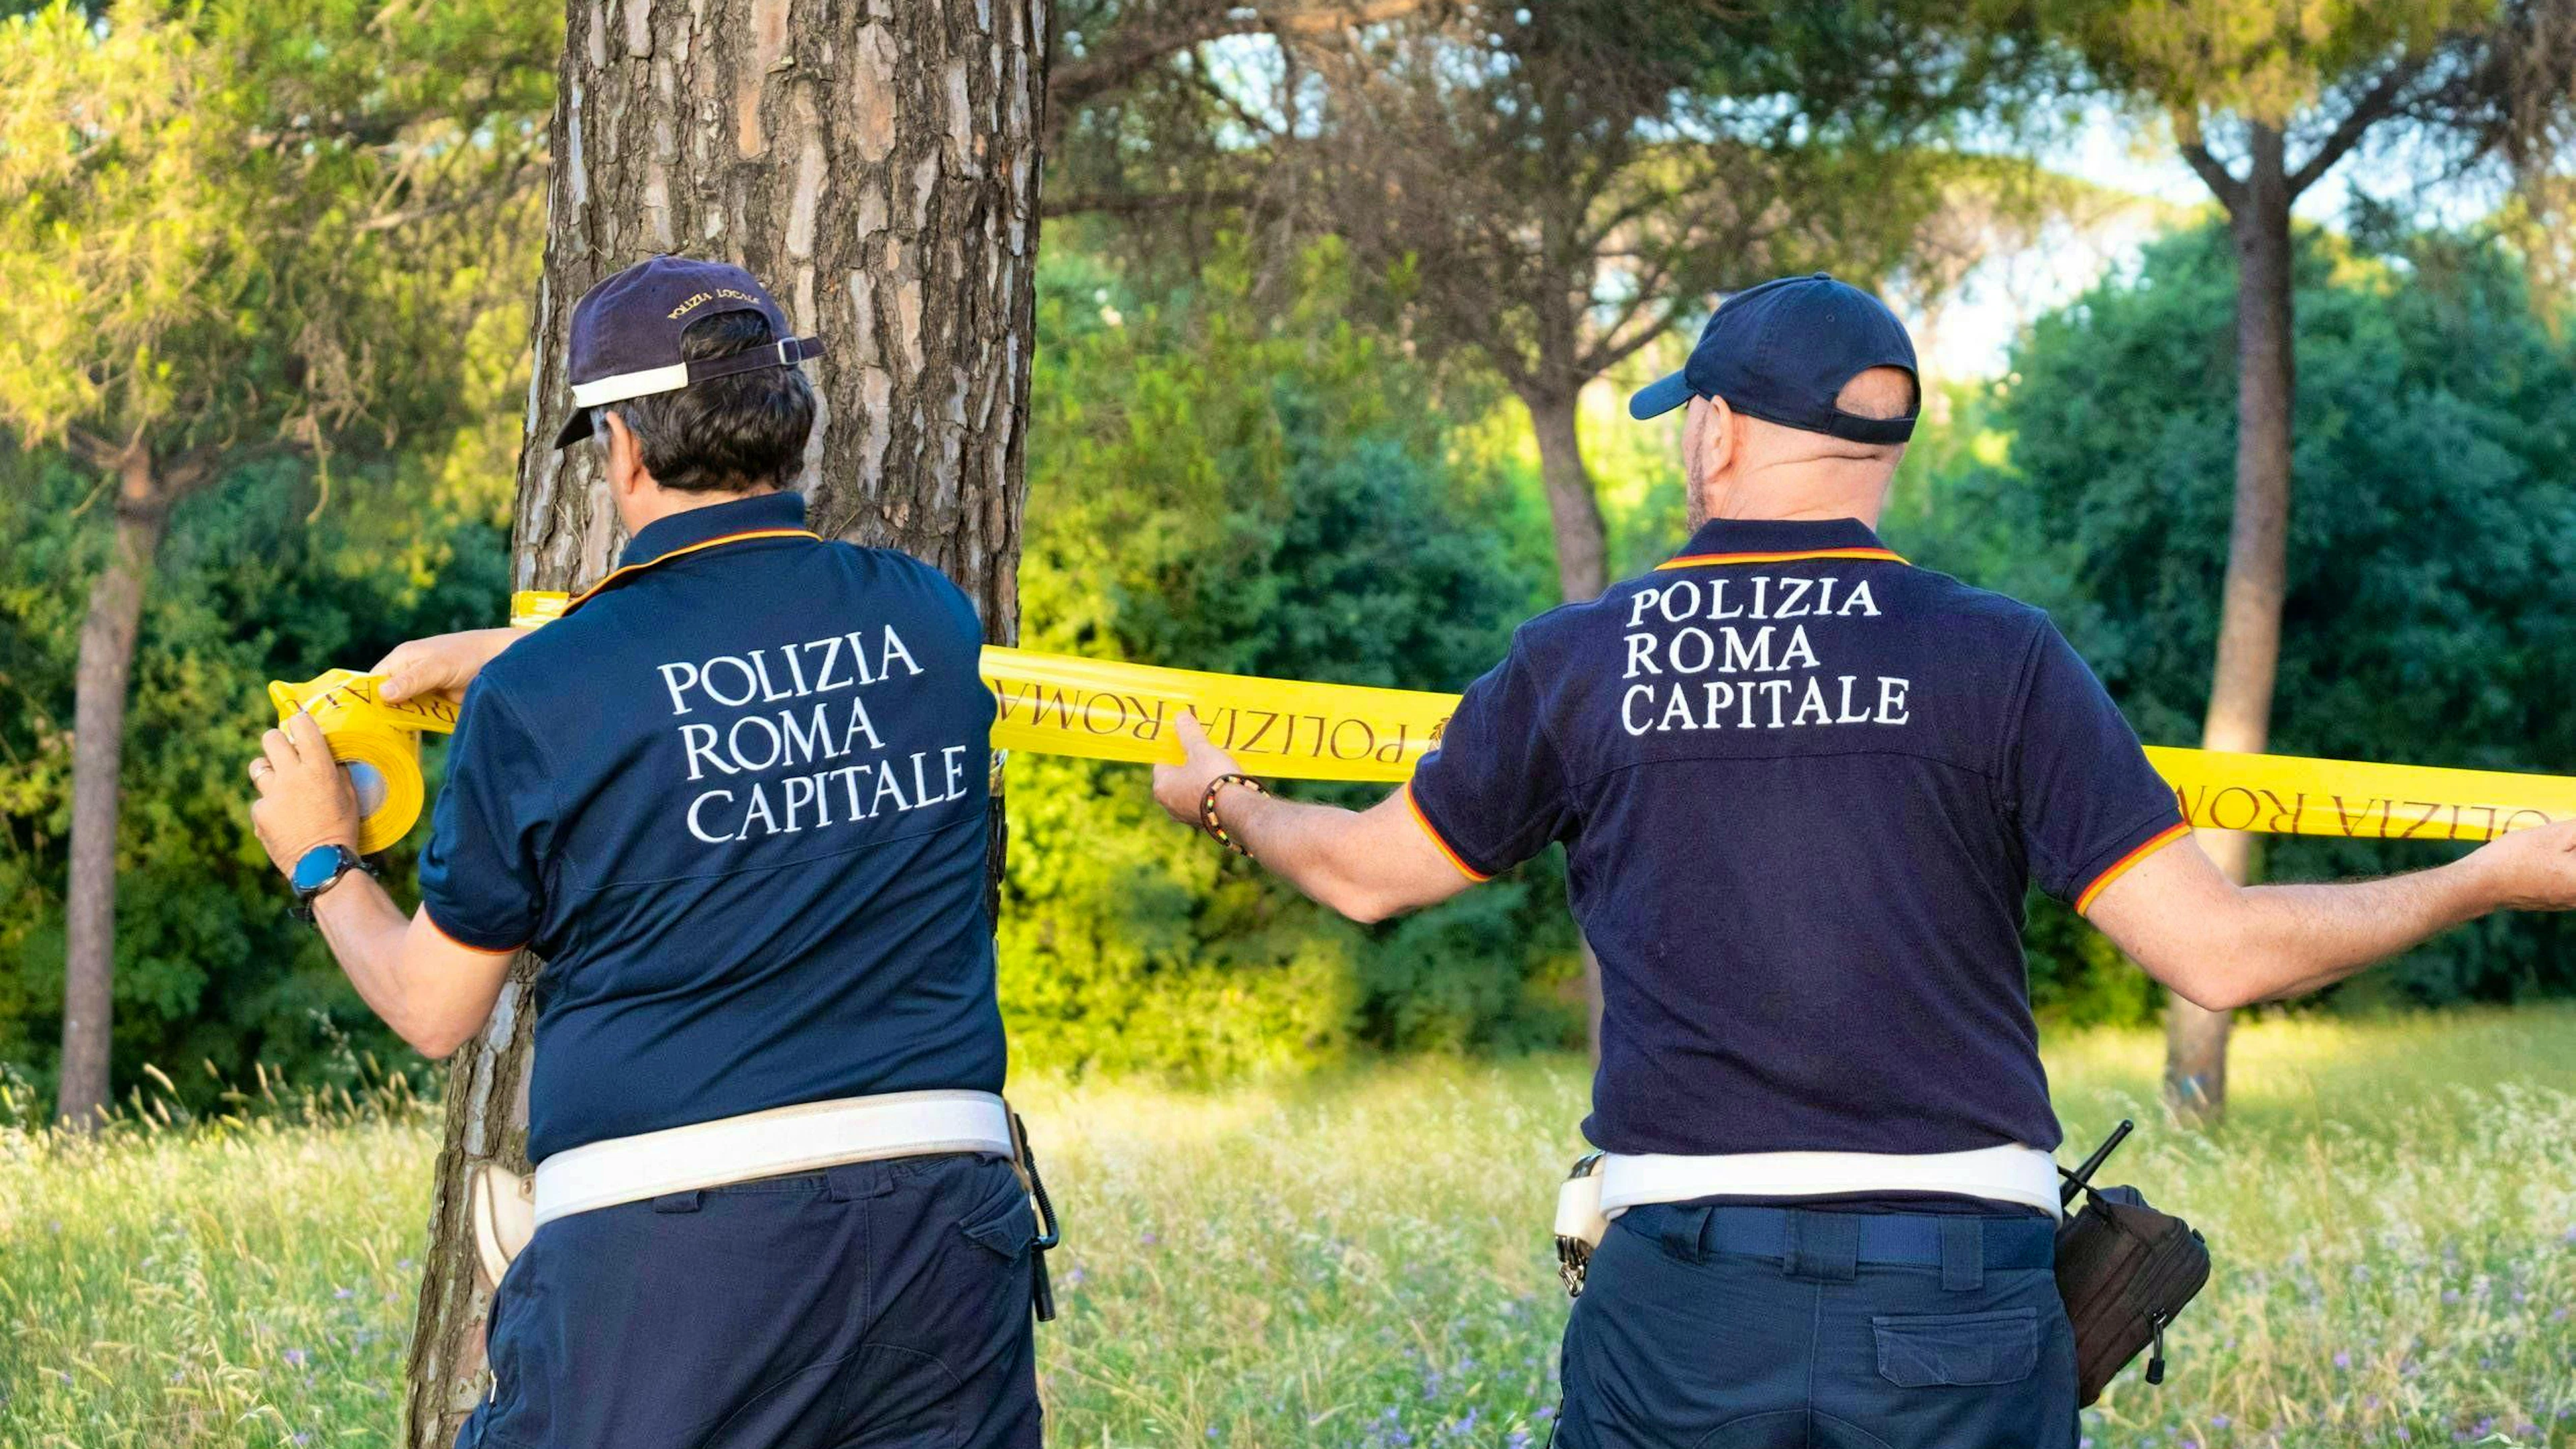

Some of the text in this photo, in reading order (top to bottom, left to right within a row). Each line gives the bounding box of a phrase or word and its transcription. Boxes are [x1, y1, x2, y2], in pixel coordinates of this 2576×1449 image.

[667, 288, 759, 319] POLIZIA LOCALE
[1626, 576, 1882, 627] POLIZIA
[657, 625, 924, 715] POLIZIA
[1622, 624, 1821, 679] ROMA
[678, 696, 885, 781] ROMA
[993, 680, 1407, 763] POLIZIA ROMA
[1621, 675, 1910, 736] CAPITALE
[687, 745, 967, 843] CAPITALE
